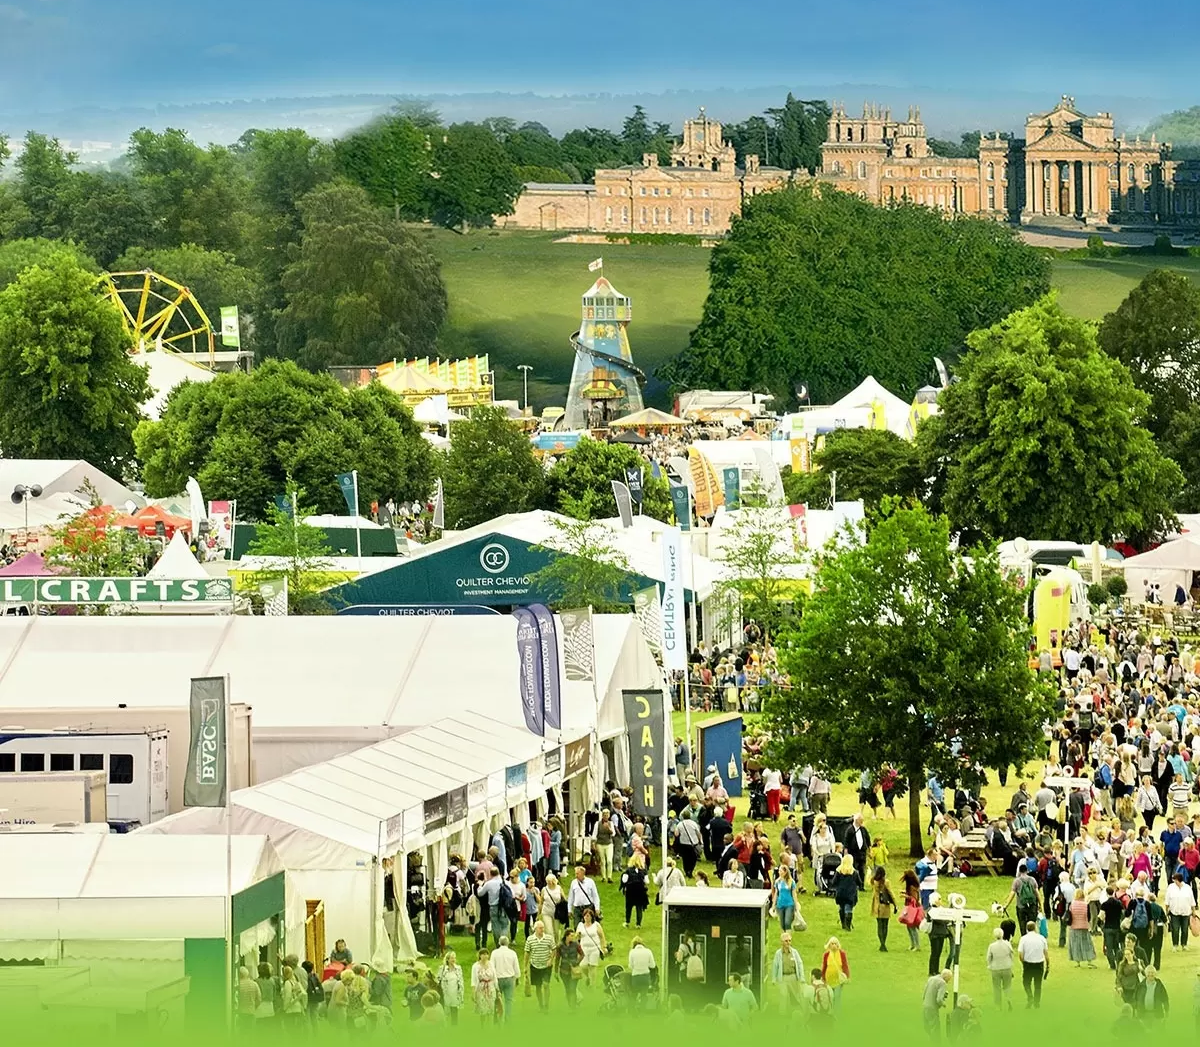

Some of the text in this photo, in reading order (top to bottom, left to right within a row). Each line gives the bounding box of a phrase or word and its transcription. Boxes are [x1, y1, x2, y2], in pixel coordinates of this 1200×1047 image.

[456, 576, 530, 588] QUILTER CHEVIO
[40, 580, 200, 601] CRAFTS
